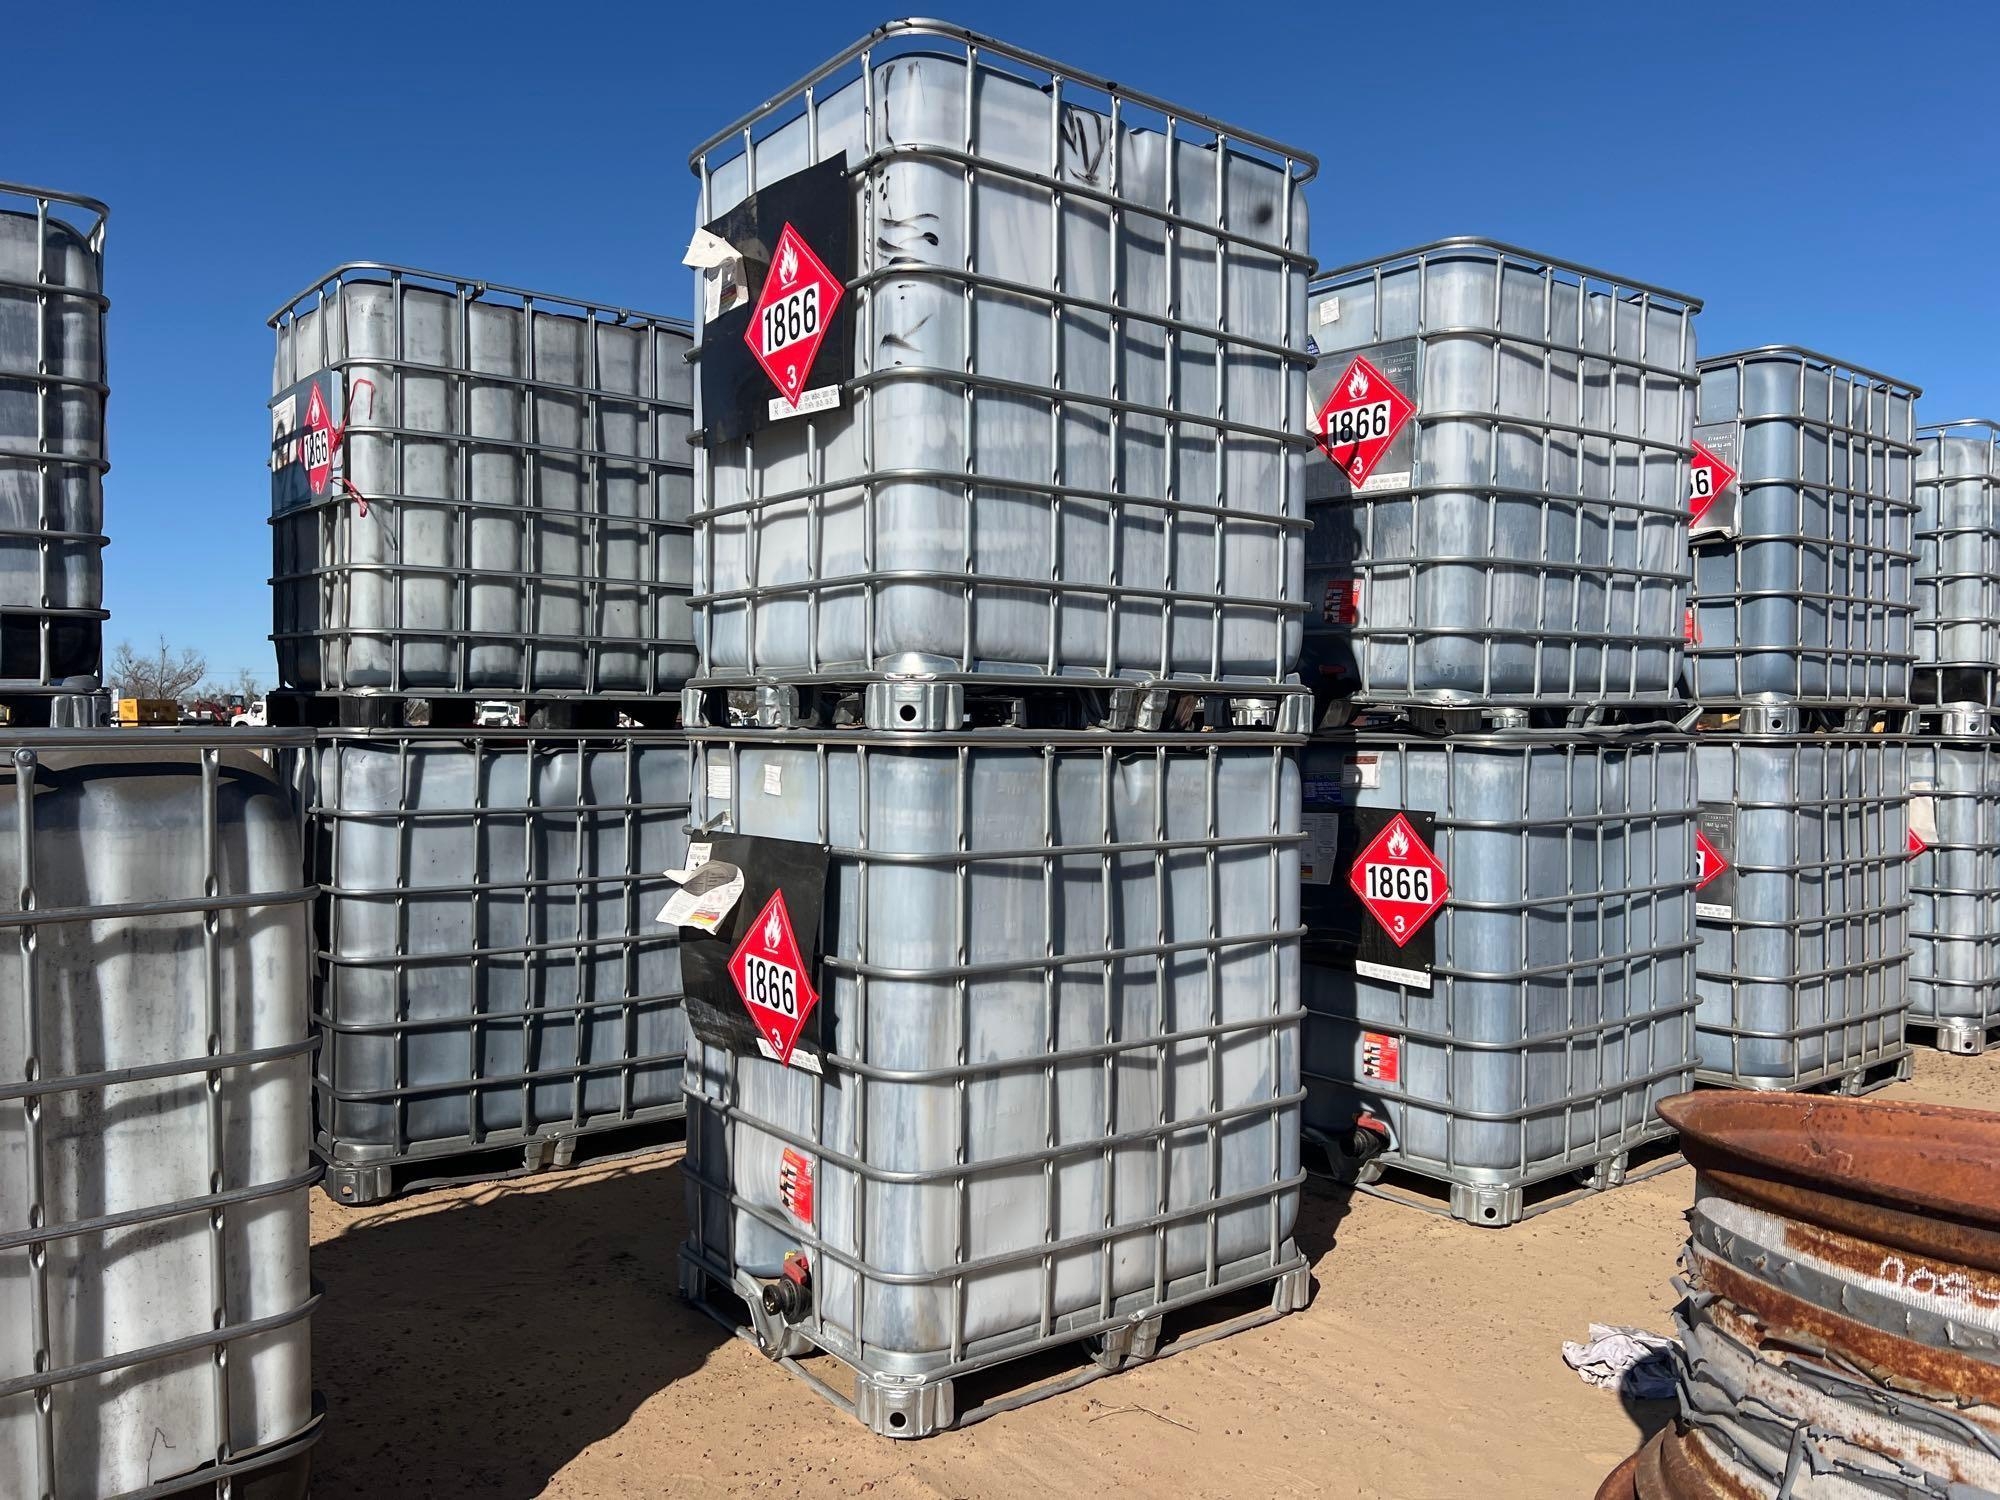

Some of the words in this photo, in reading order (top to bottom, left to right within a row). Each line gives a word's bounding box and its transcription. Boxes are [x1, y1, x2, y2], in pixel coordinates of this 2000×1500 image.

[765, 288, 816, 351] 1866
[786, 364, 797, 389] 3
[1329, 403, 1387, 446] 1866
[305, 430, 328, 468] 1866
[1353, 456, 1364, 475] 3
[1368, 866, 1429, 902] 1866
[1393, 915, 1406, 933] 3
[747, 957, 795, 1015] 1866
[771, 1027, 784, 1050] 3
